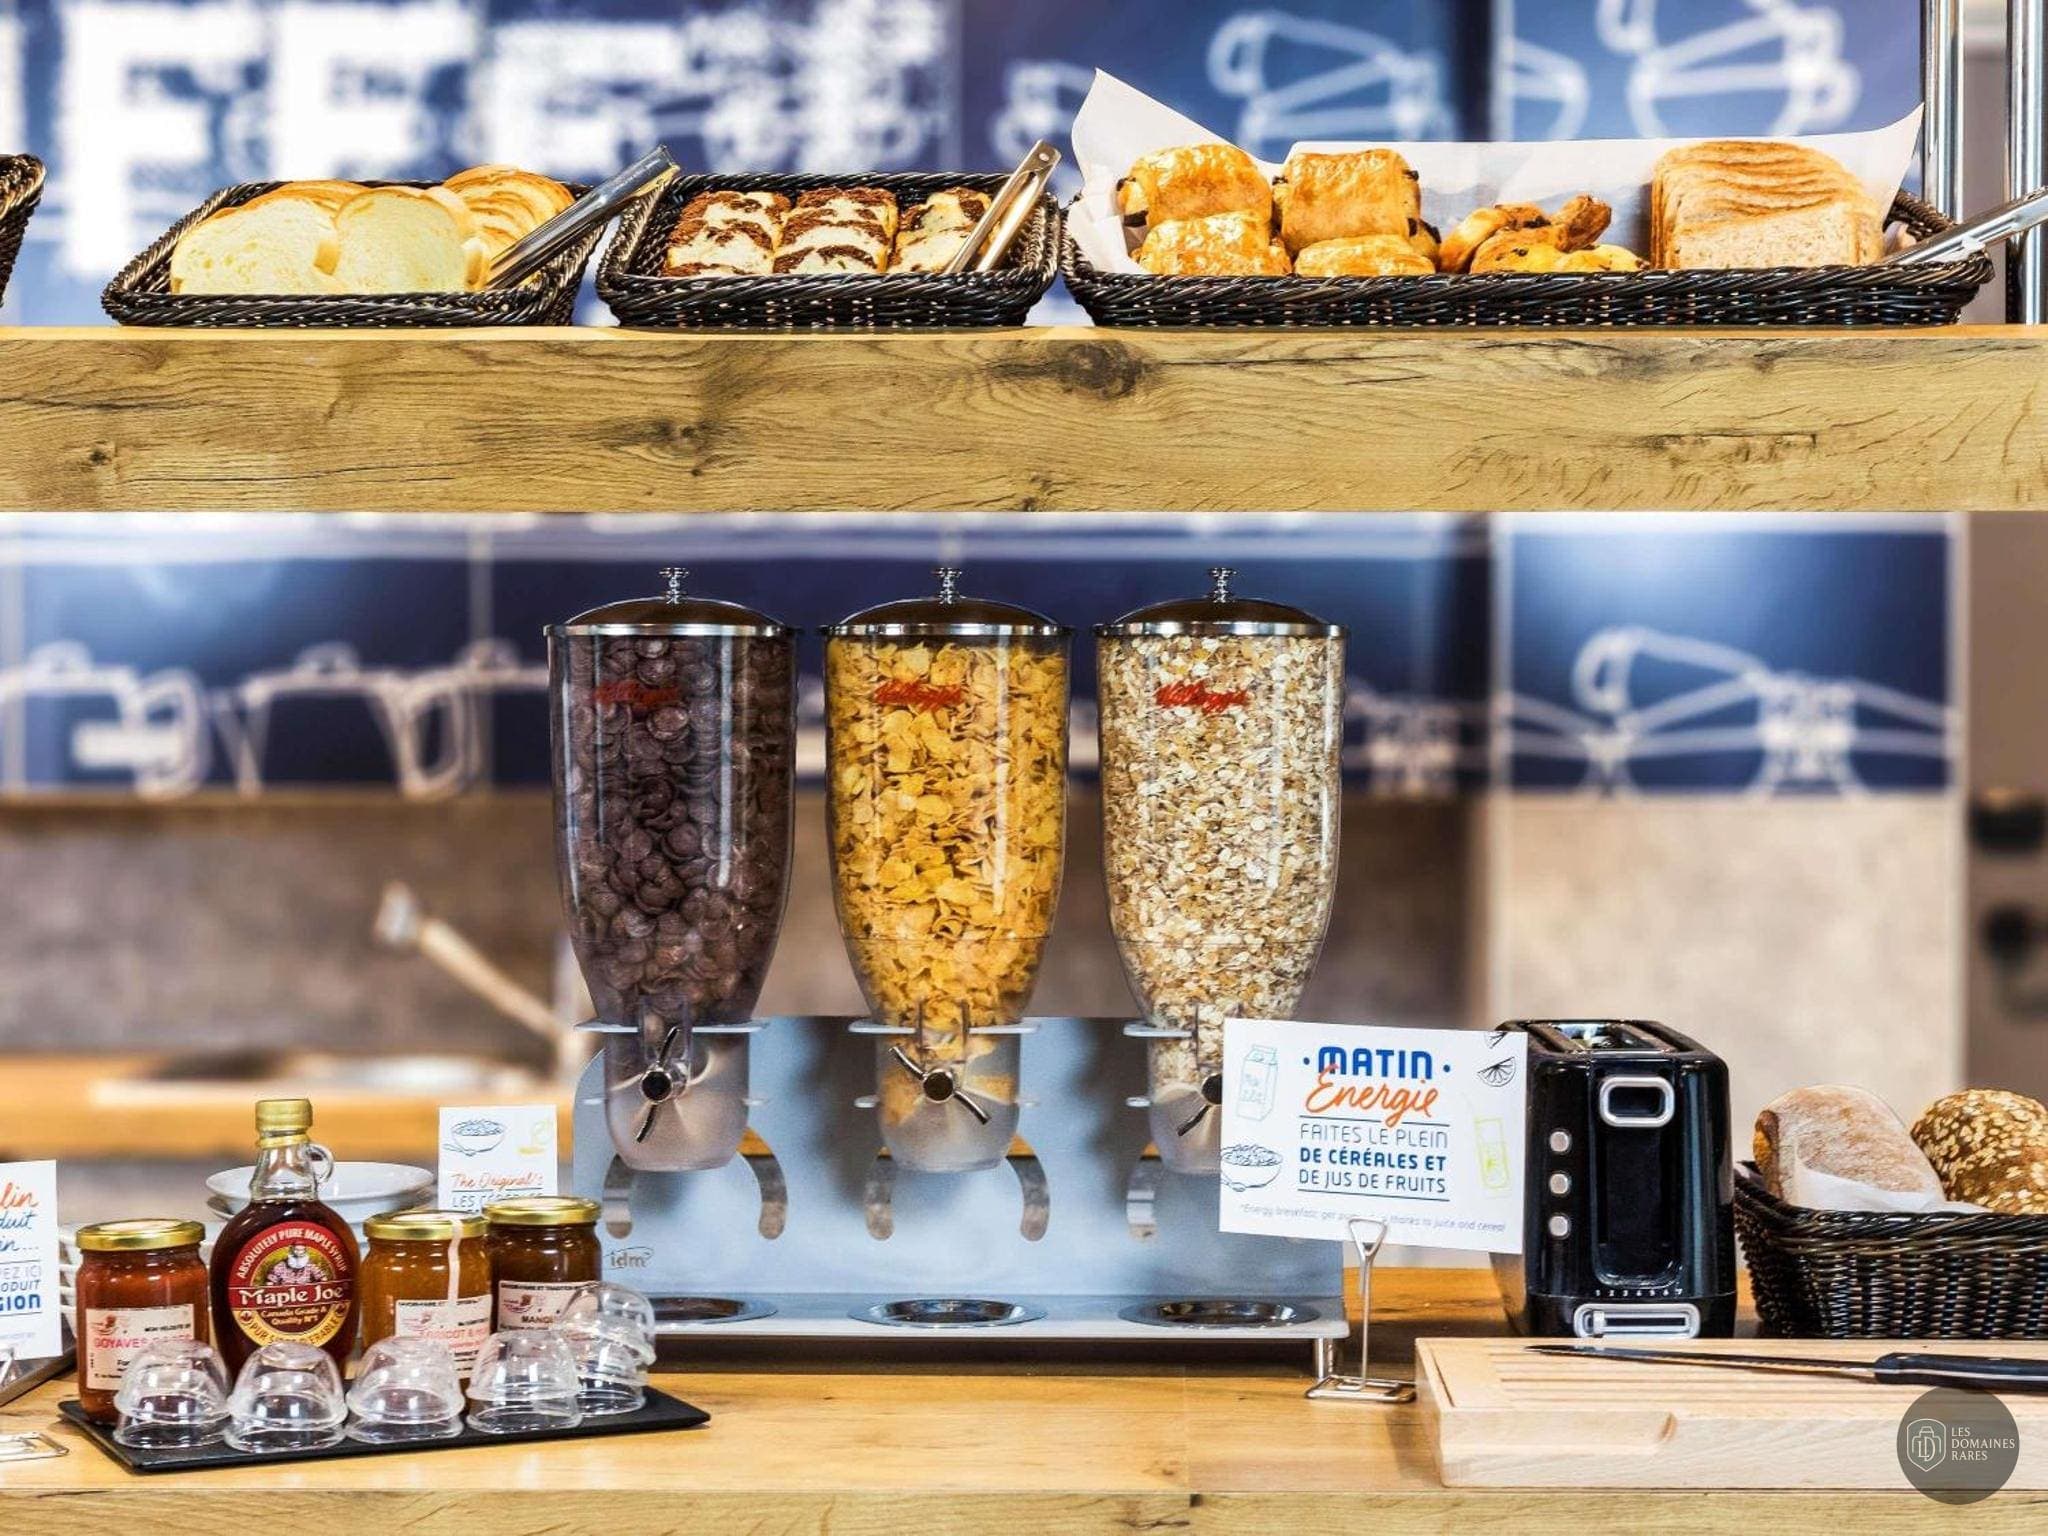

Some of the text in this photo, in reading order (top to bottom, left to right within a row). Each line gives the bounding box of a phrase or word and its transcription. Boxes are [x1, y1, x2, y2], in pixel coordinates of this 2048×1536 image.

[1318, 1046, 1433, 1080] MATIN
[1300, 1122, 1449, 1149] FAITES LE PLEIN
[1300, 1146, 1447, 1171] DE CÉRÉALES ET
[1299, 1169, 1446, 1193] DE JUS DE FRUITS
[236, 1232, 279, 1279] ABSOLUTELY
[278, 1228, 304, 1240] PURE
[303, 1229, 332, 1250] MAPLE
[239, 1284, 344, 1307] Maple Joe
